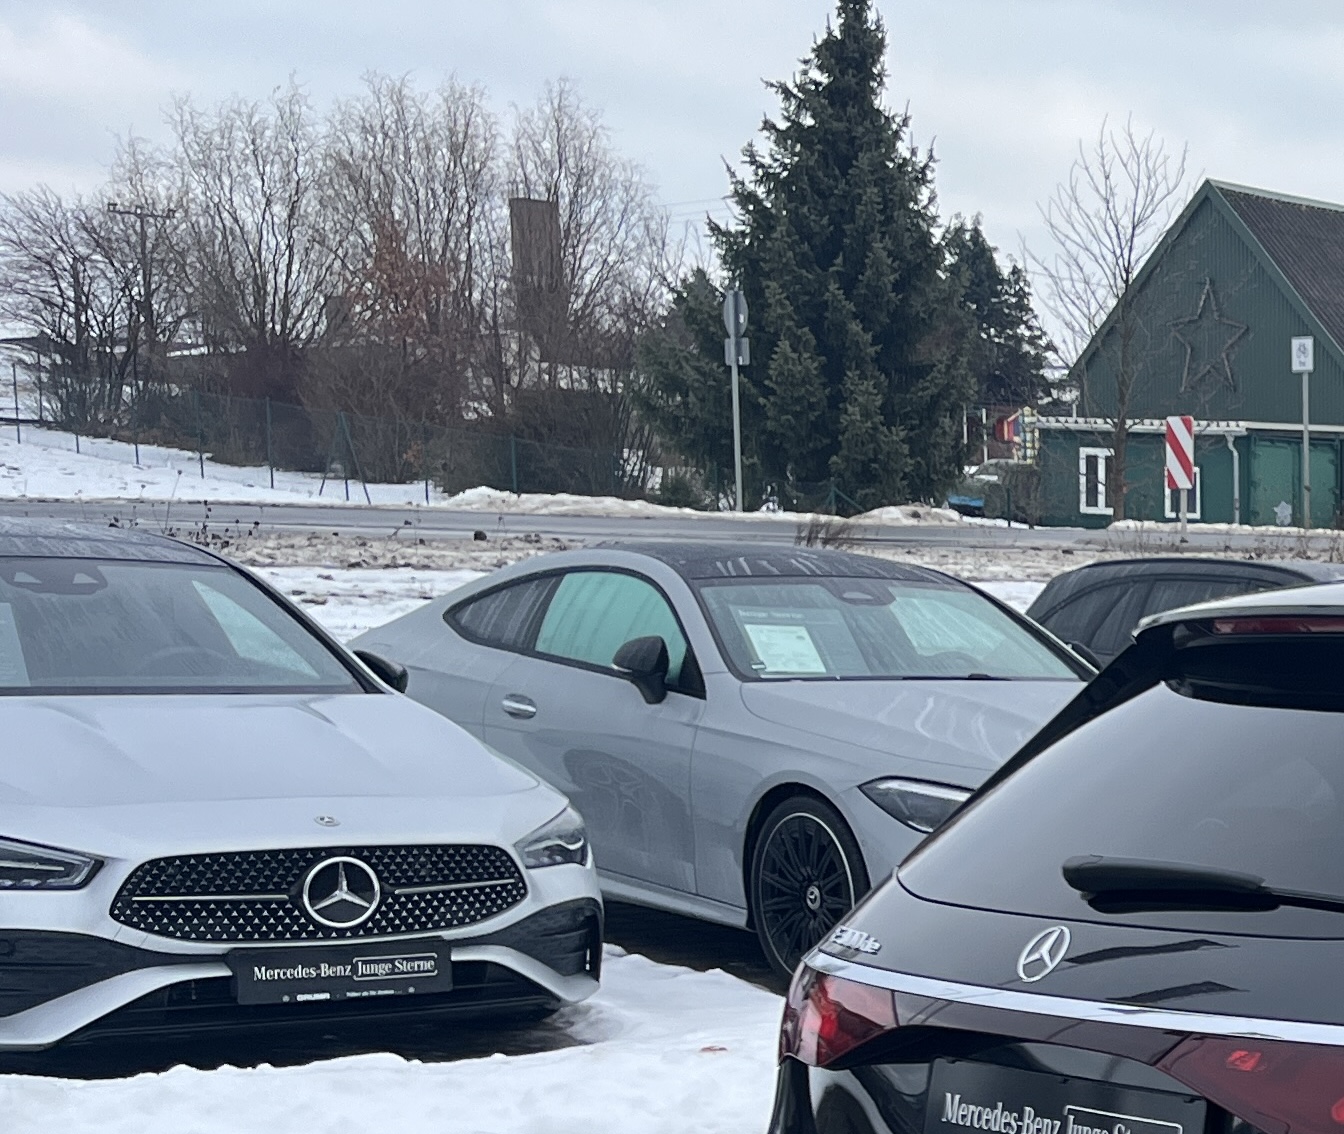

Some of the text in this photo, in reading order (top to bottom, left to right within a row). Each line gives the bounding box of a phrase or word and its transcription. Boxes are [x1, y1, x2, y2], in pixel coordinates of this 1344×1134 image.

[253, 959, 435, 981] Mercedes-Benz Junge Sterne
